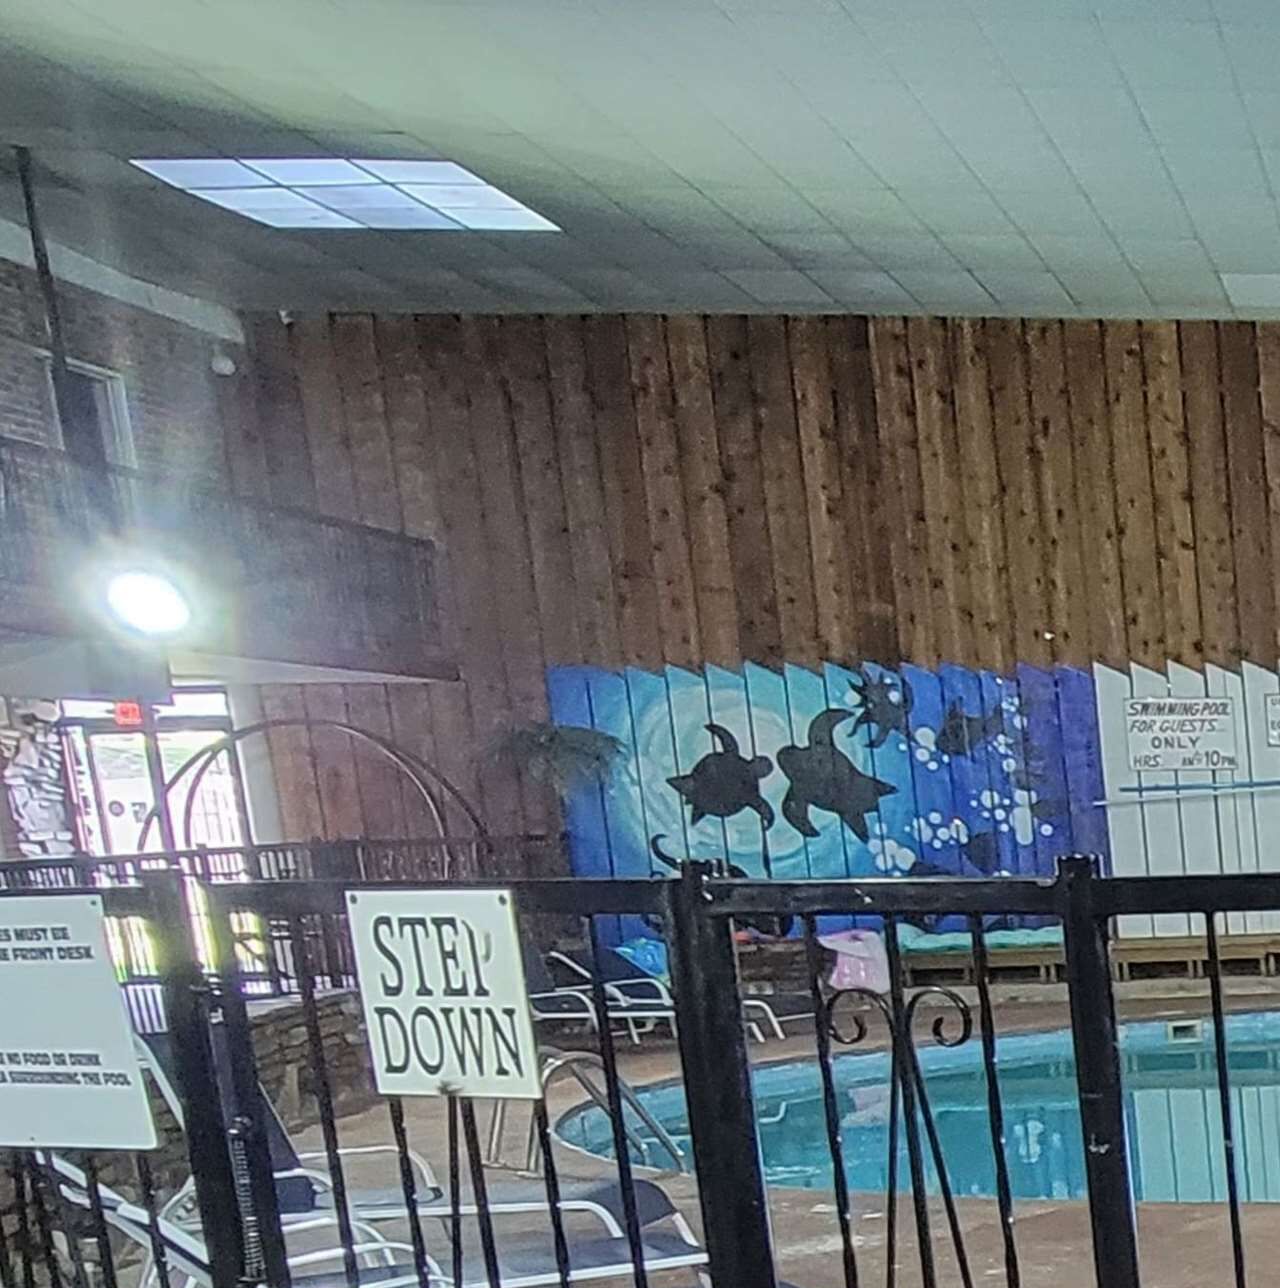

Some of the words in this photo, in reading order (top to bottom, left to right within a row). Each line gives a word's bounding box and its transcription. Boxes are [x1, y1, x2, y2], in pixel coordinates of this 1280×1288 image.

[1130, 720, 1156, 733] FOR
[1160, 719, 1217, 733] GUESTS
[1151, 736, 1200, 749] ONLY
[13, 927, 48, 941] MUST
[12, 947, 54, 961] FRONT
[56, 945, 95, 960] DESK
[373, 915, 493, 997] STEP
[373, 1005, 523, 1078] DOWN
[102, 1072, 132, 1086] POOL
